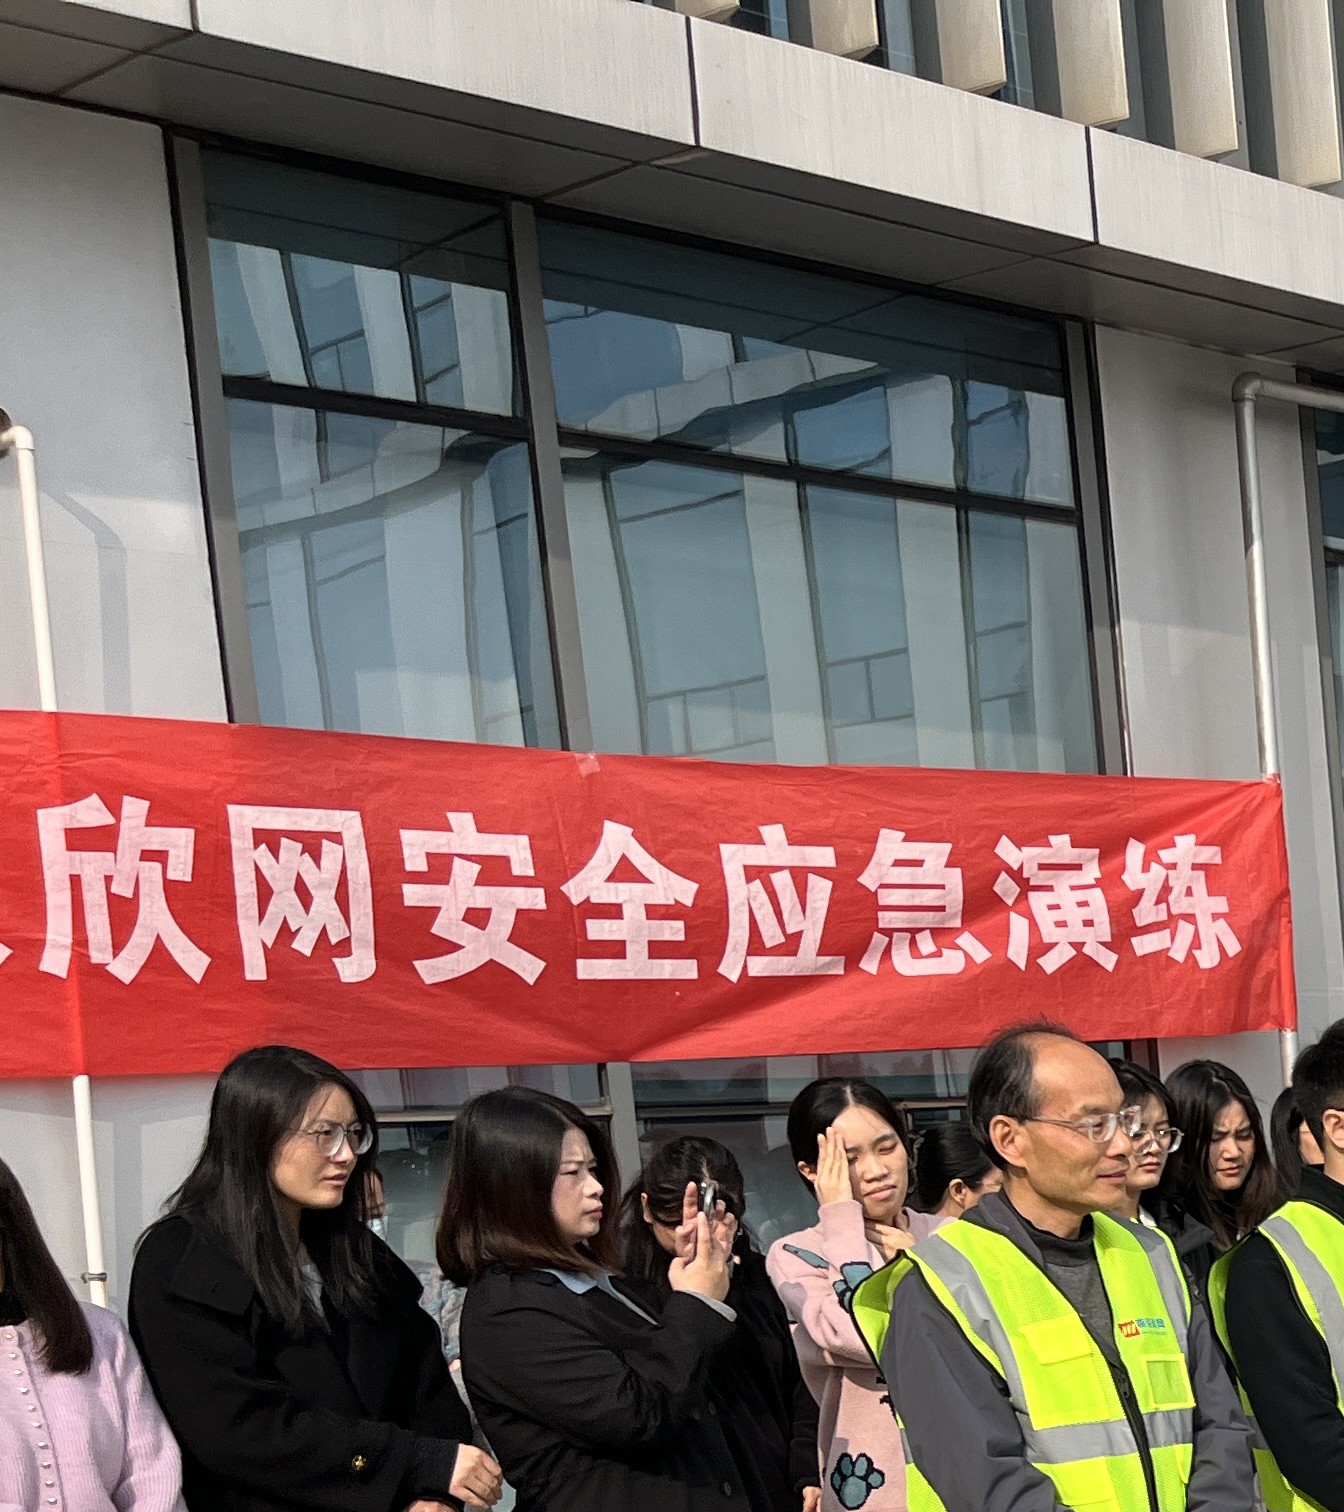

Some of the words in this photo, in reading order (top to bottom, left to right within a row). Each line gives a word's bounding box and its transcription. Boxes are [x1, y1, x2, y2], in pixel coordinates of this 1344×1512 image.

[0, 792, 1242, 985] 欣网安全应急演练
